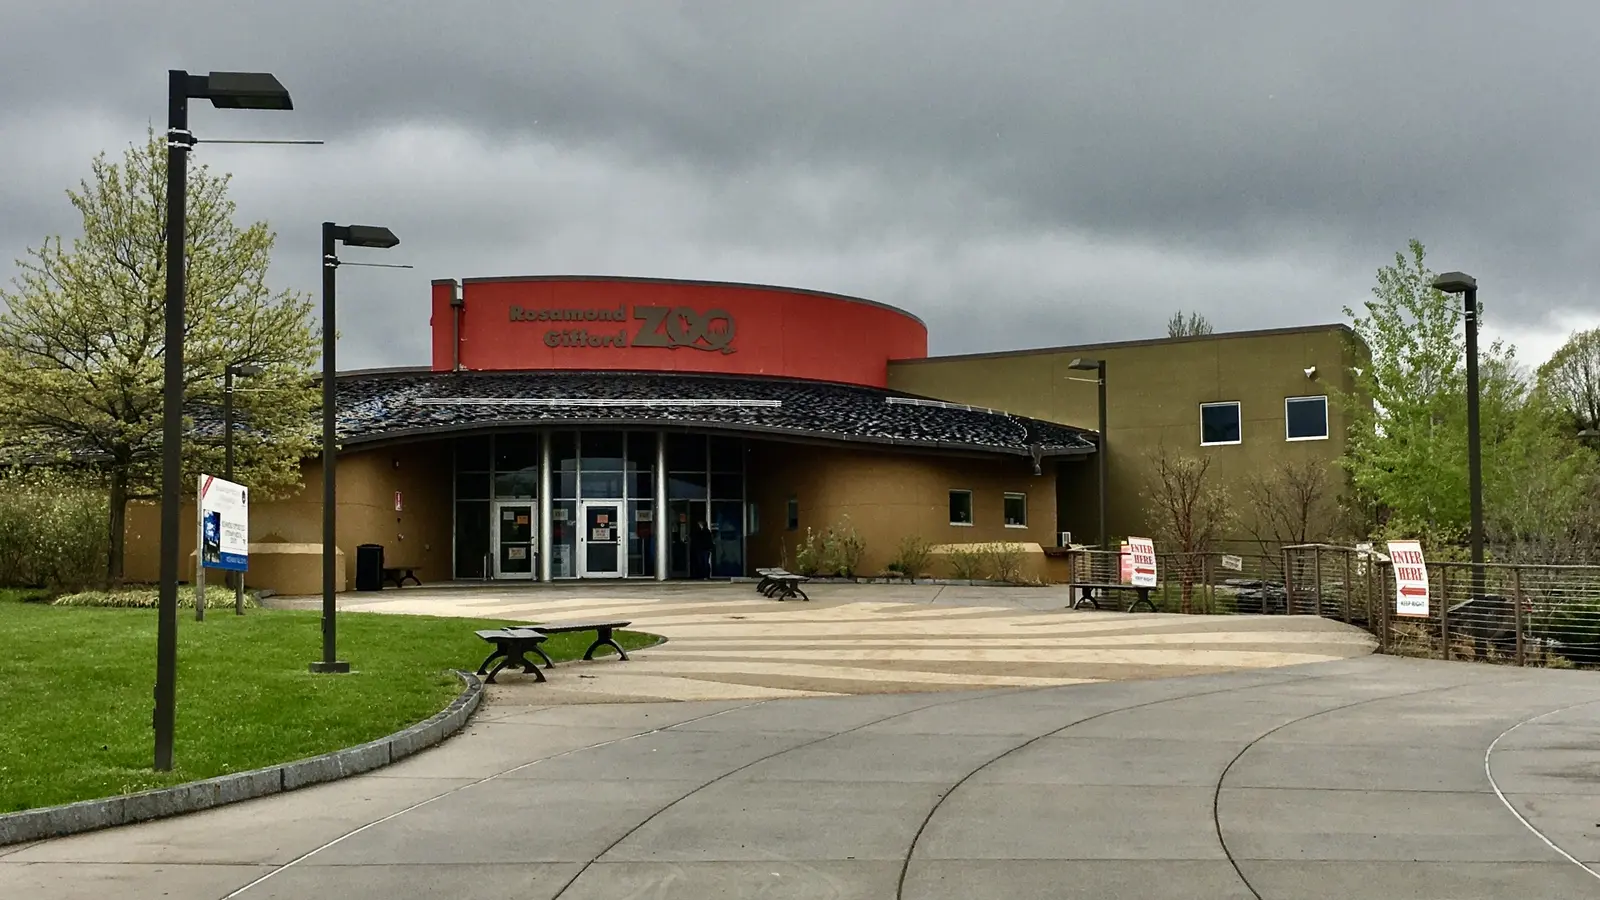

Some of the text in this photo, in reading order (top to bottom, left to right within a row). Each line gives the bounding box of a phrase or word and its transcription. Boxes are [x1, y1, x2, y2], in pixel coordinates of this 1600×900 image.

[510, 305, 626, 322] Rosamond
[543, 306, 737, 354] Gifford ZOO
[1131, 544, 1153, 554] ENTER
[1134, 554, 1153, 564] HERE
[1391, 551, 1423, 564] ENTER
[1398, 567, 1424, 581] HERE
